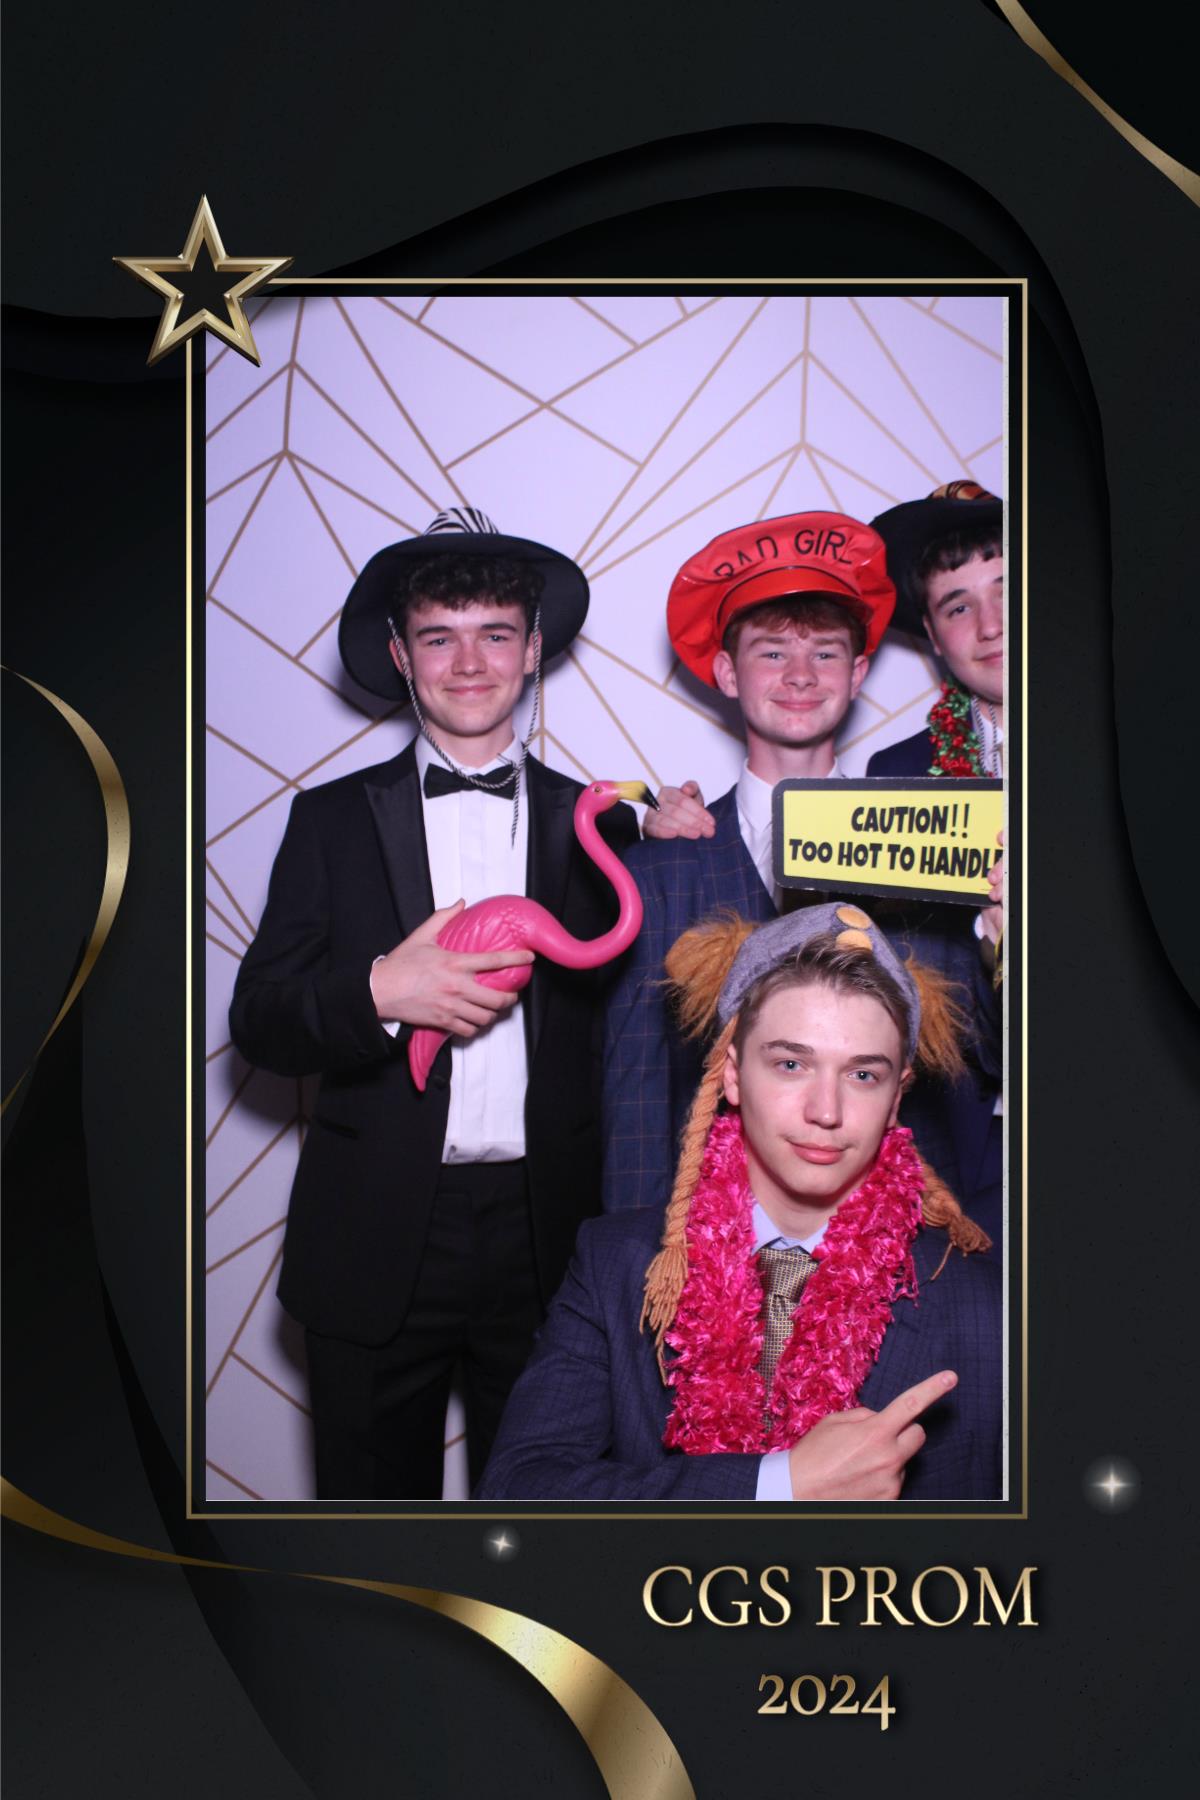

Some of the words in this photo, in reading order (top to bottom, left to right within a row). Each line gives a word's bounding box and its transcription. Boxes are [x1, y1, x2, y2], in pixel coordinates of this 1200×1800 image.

[851, 804, 970, 838] CAUTION!!
[789, 839, 833, 863] TOO
[837, 842, 882, 868] HOT
[888, 844, 915, 871] TO
